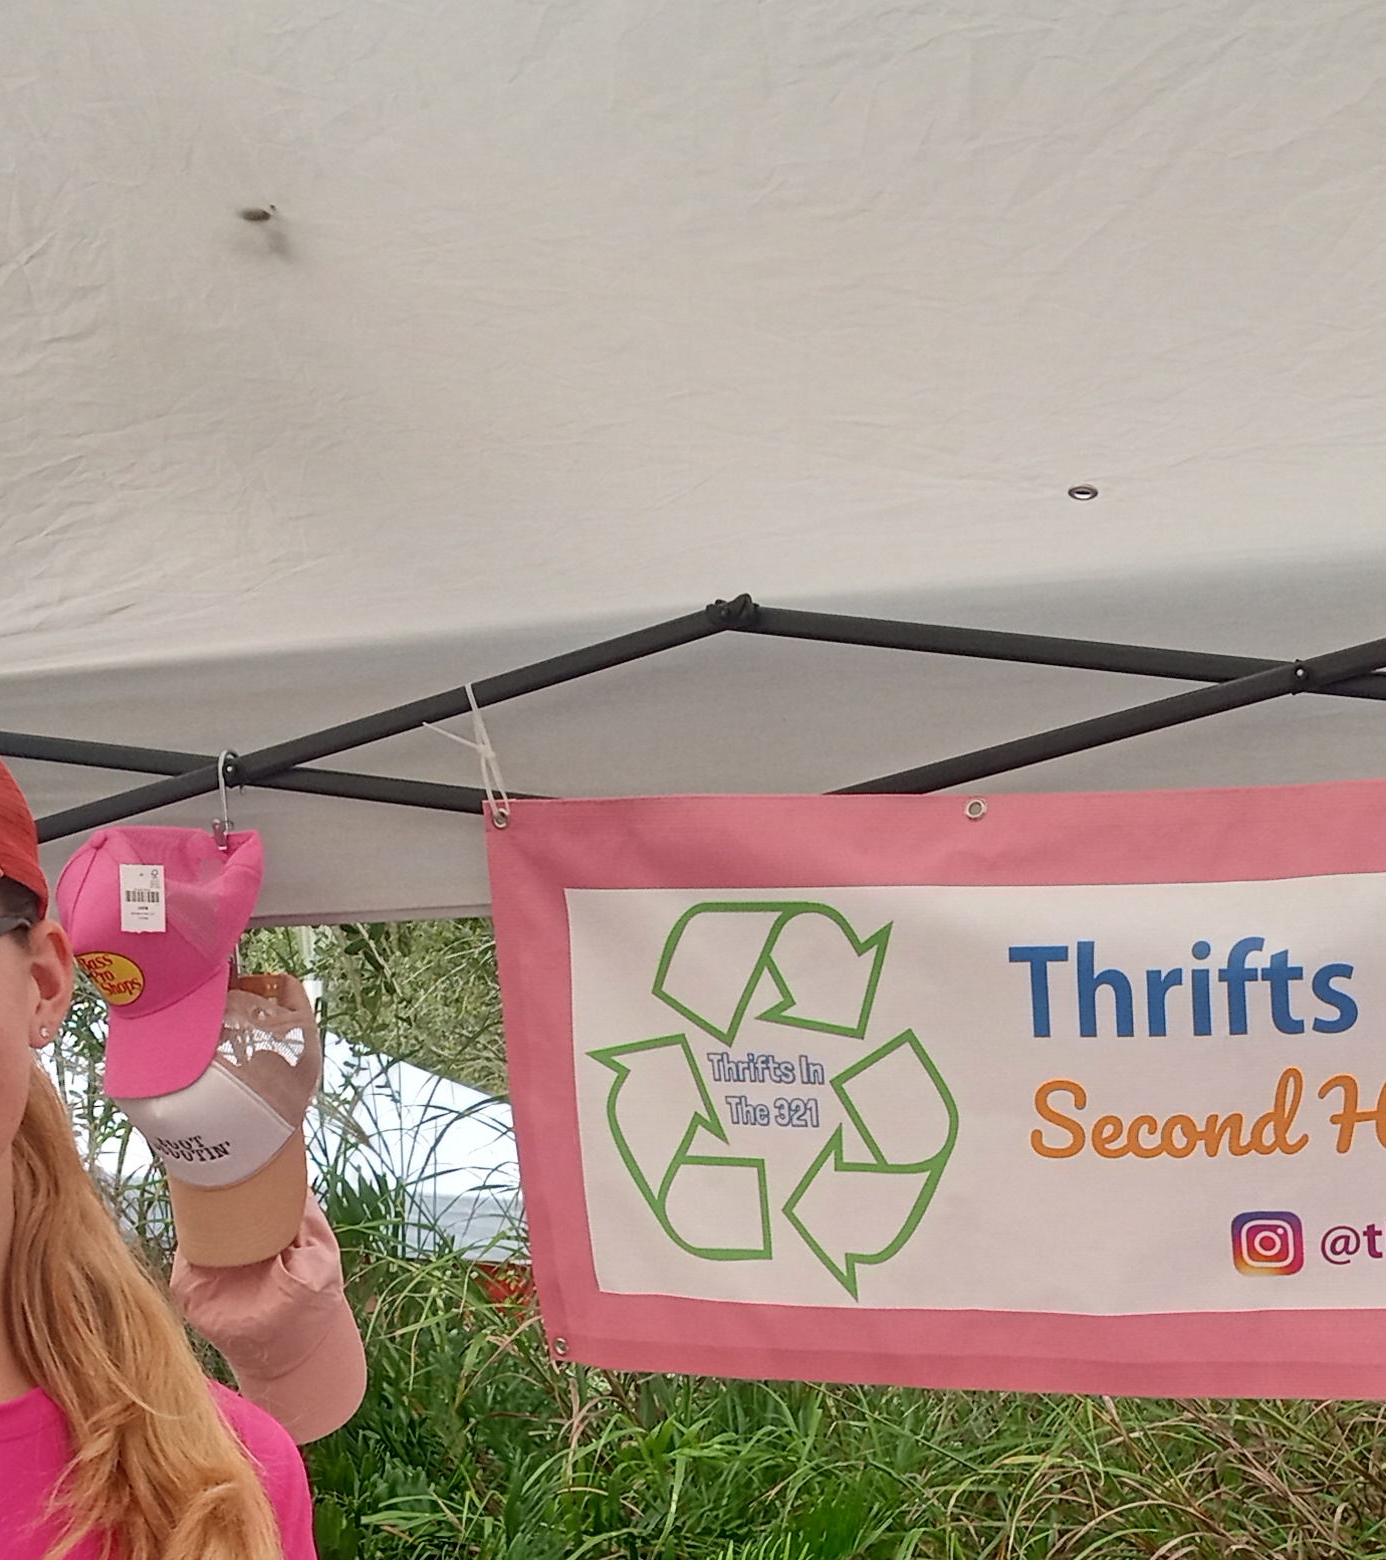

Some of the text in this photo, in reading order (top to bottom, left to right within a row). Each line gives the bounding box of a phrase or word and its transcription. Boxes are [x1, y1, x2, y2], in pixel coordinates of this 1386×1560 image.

[92, 970, 115, 984] Pro
[103, 977, 142, 997] Shops
[1008, 937, 1359, 1041] Thrifts
[707, 1052, 825, 1085] Thrifts In
[725, 1095, 819, 1128] The 321
[1031, 1066, 1310, 1163] Second
